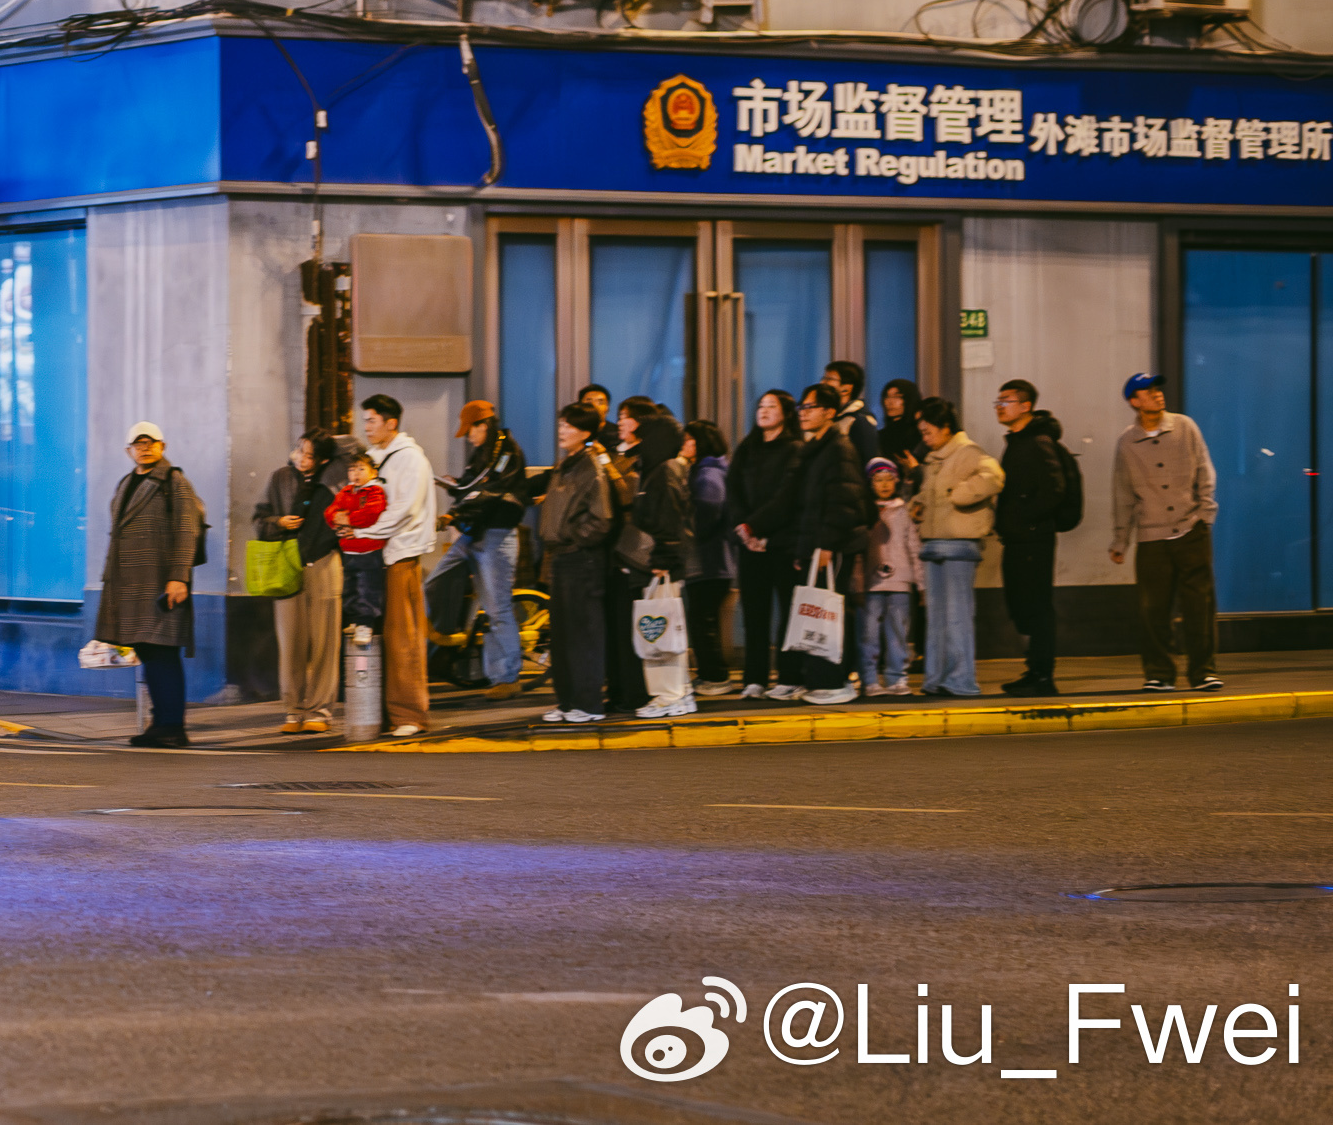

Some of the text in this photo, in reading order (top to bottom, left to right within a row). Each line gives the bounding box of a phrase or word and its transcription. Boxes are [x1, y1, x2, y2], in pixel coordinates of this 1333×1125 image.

[732, 78, 1025, 143] 市场监督管理
[1028, 112, 1333, 161] 外滩市场监督管理所
[733, 143, 1026, 184] Market Regulation
